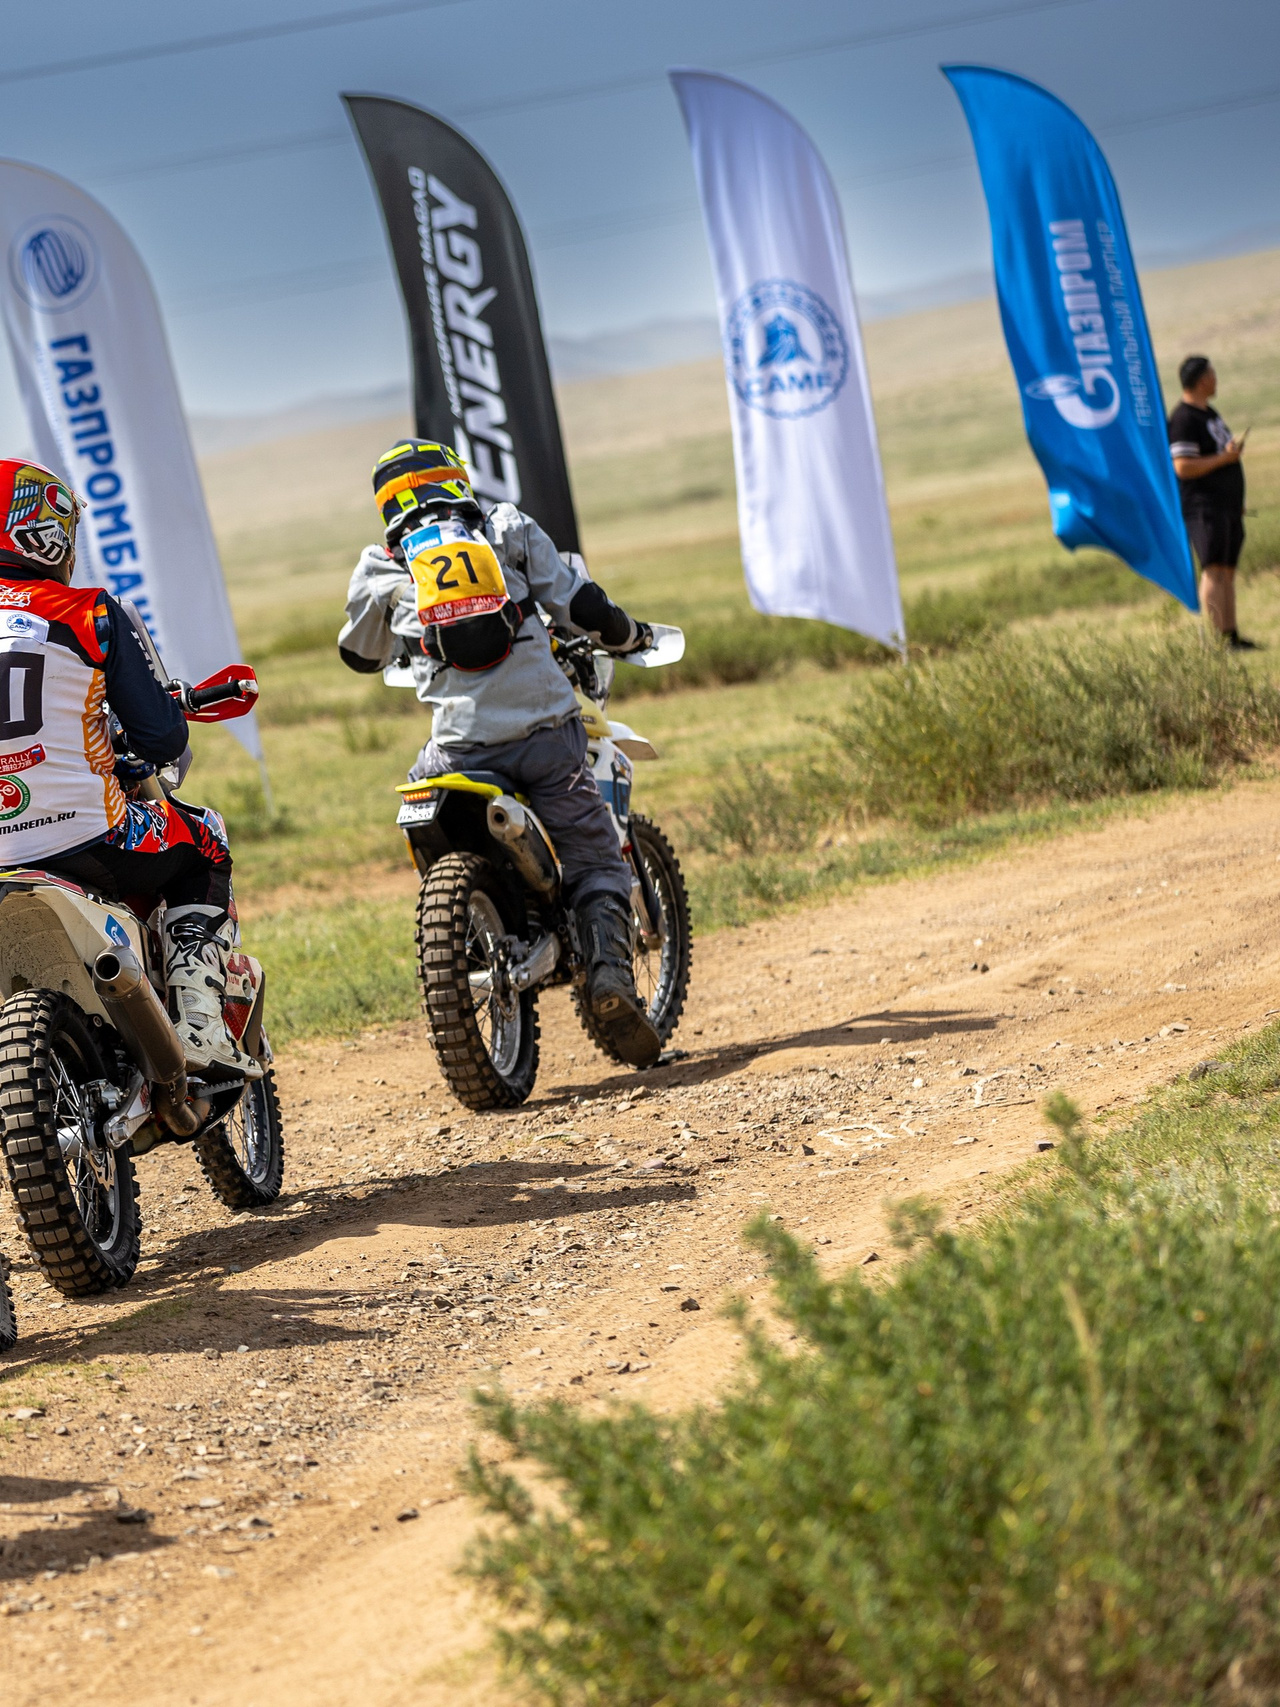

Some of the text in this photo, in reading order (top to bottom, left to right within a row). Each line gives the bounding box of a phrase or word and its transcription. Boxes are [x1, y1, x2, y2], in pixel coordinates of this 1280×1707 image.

[1049, 218, 1113, 368] ГАЗПРОМ
[50, 331, 162, 654] ГАЗПРОМБА
[430, 551, 479, 591] 21
[471, 597, 497, 606] RALLY
[435, 611, 453, 620] WAY
[1, 752, 31, 765] RALLY
